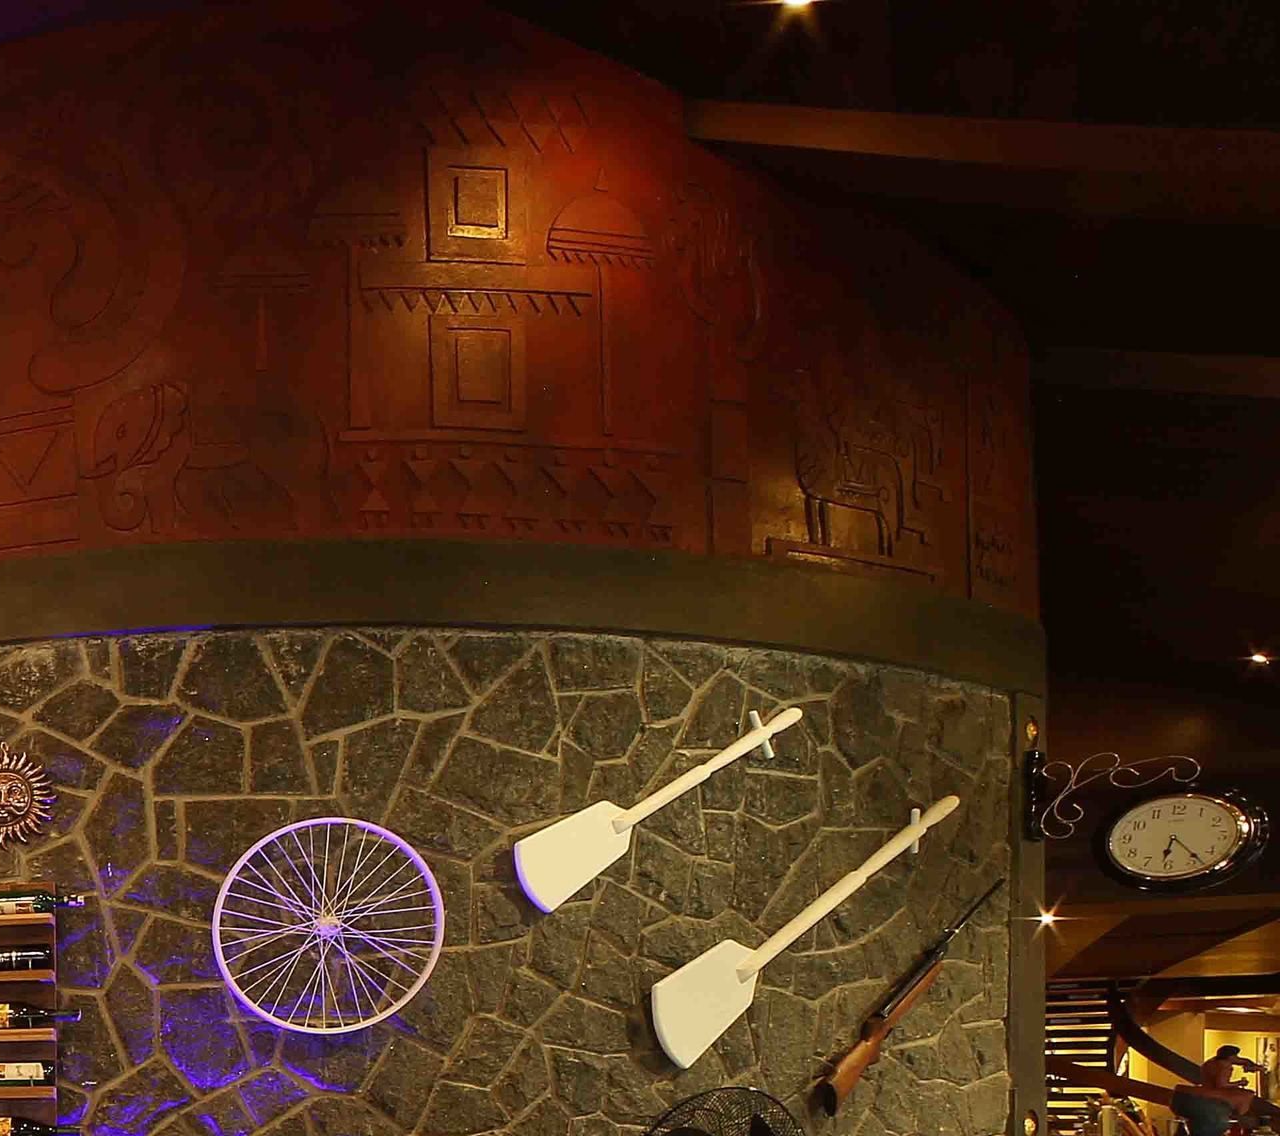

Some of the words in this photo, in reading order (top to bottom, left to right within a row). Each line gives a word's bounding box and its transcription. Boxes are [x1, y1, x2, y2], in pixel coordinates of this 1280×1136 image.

[1151, 809, 1162, 820] 11
[1171, 804, 1187, 816] 12
[1133, 820, 1146, 832] 10
[1211, 816, 1222, 828] 2
[1121, 833, 1132, 845] 9
[1127, 848, 1138, 859] 8
[1204, 845, 1215, 856] 4
[1143, 856, 1153, 868] 7
[1163, 859, 1174, 871] 6
